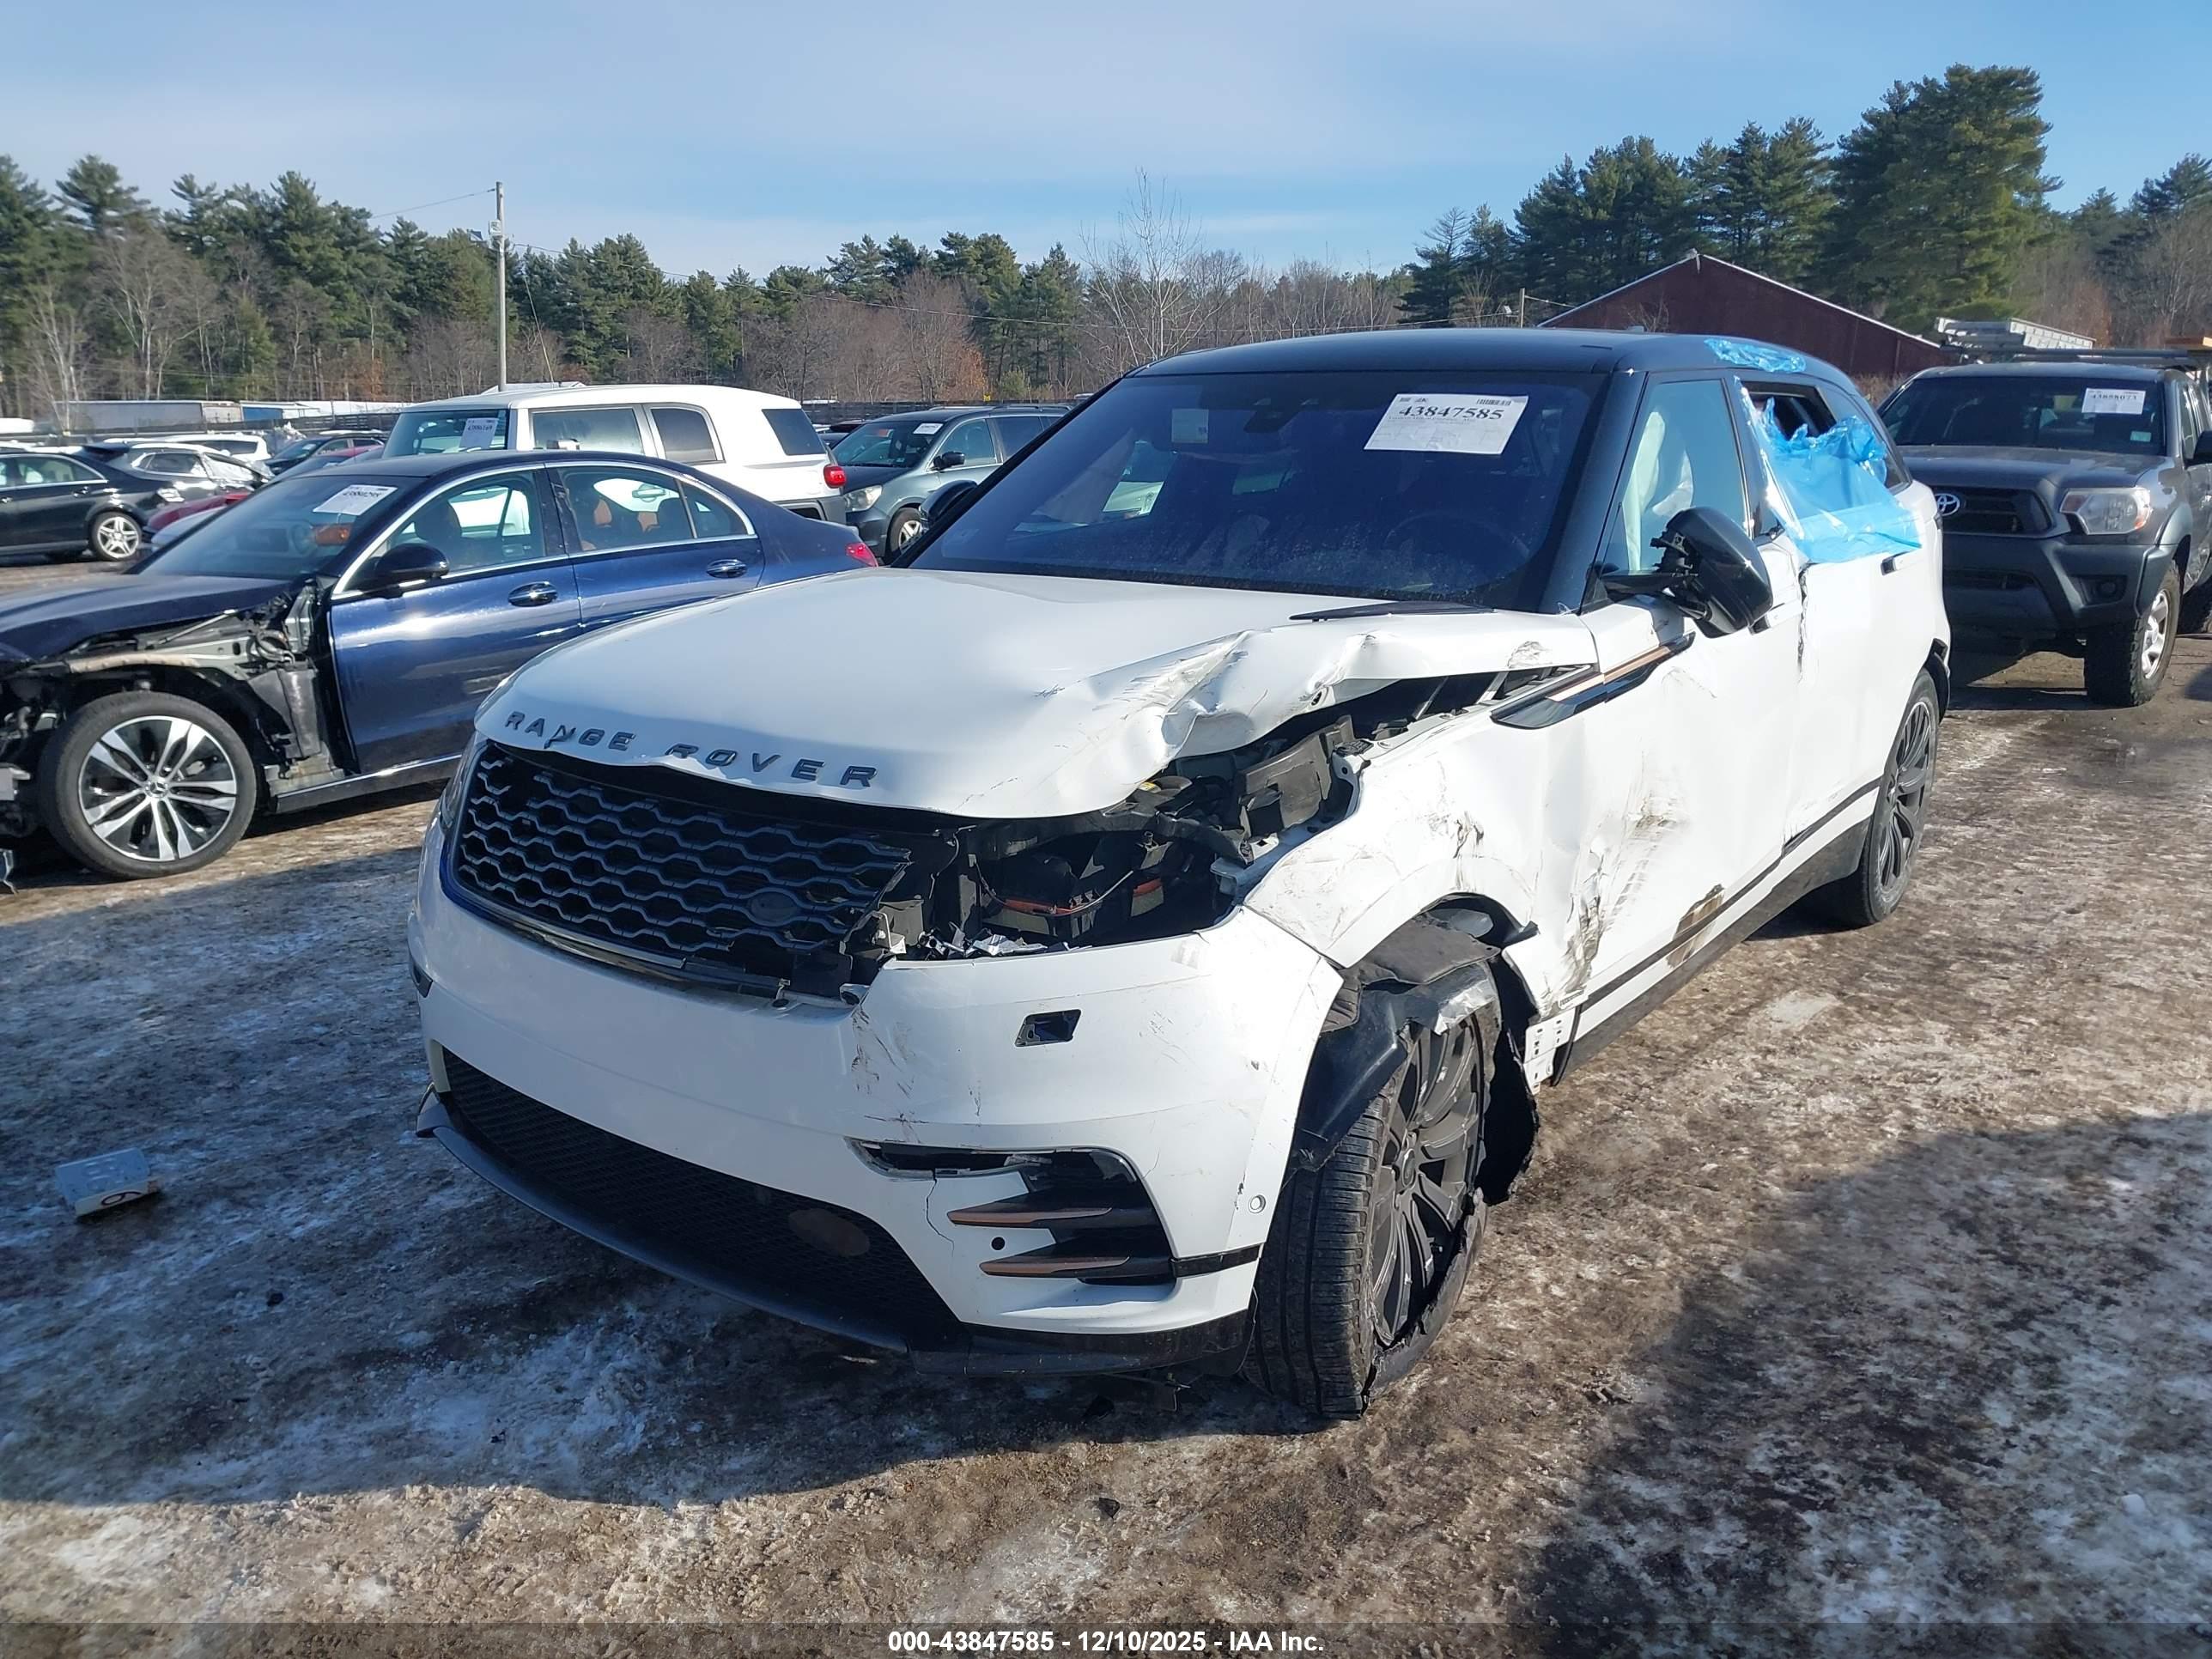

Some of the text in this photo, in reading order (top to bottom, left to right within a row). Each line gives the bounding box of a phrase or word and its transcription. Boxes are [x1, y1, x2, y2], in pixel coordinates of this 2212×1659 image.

[1398, 405, 1505, 420] 43847585
[504, 710, 878, 787] RANGE ROVER
